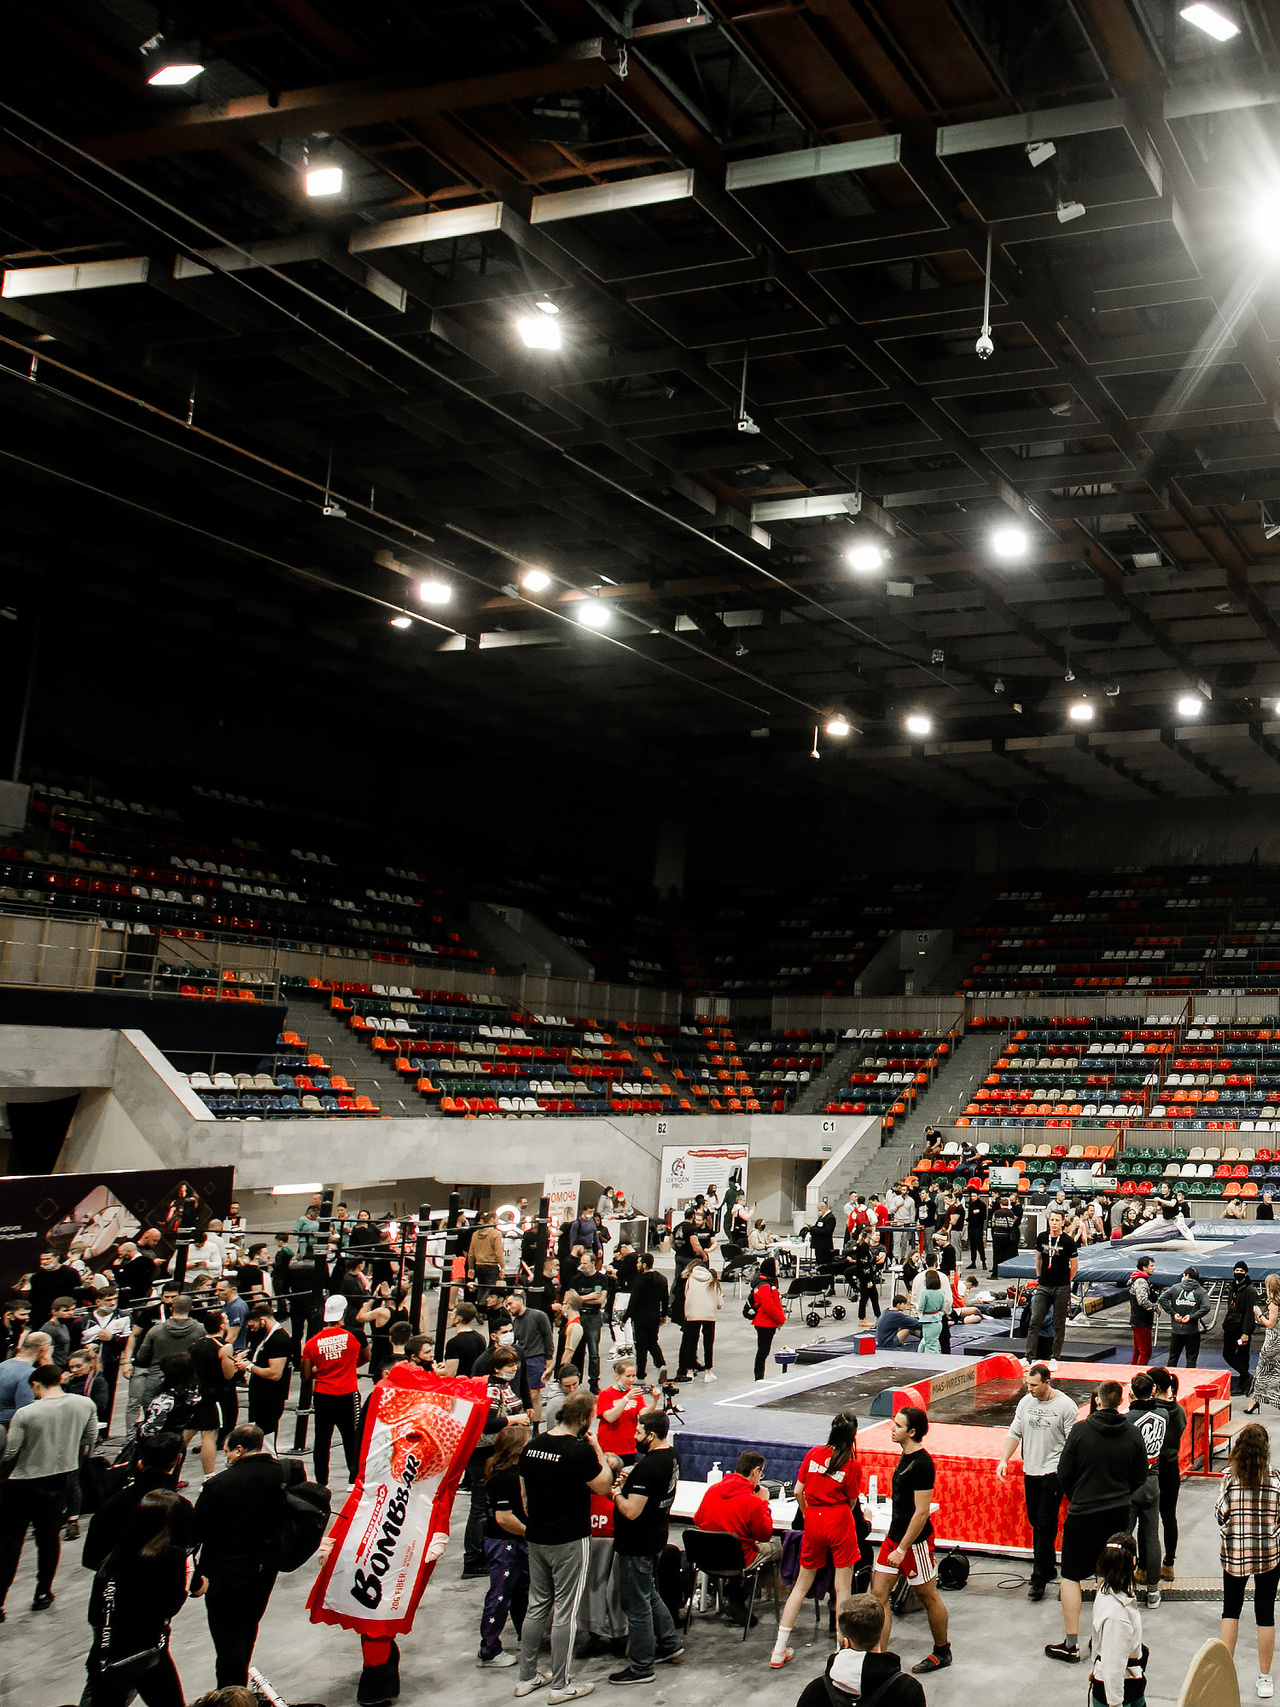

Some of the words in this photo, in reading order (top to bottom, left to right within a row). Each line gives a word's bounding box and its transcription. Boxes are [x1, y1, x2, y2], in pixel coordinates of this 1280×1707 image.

[658, 1123, 666, 1133] B2
[317, 1333, 348, 1347] MOSCOW
[319, 1342, 347, 1354] FITNESS
[325, 1351, 342, 1360] FEST
[932, 1371, 975, 1393] MAS-WRESTLING
[350, 1454, 422, 1609] BOMBBAR
[395, 1573, 407, 1593] FIBER
[101, 1627, 111, 1648] LOVE
